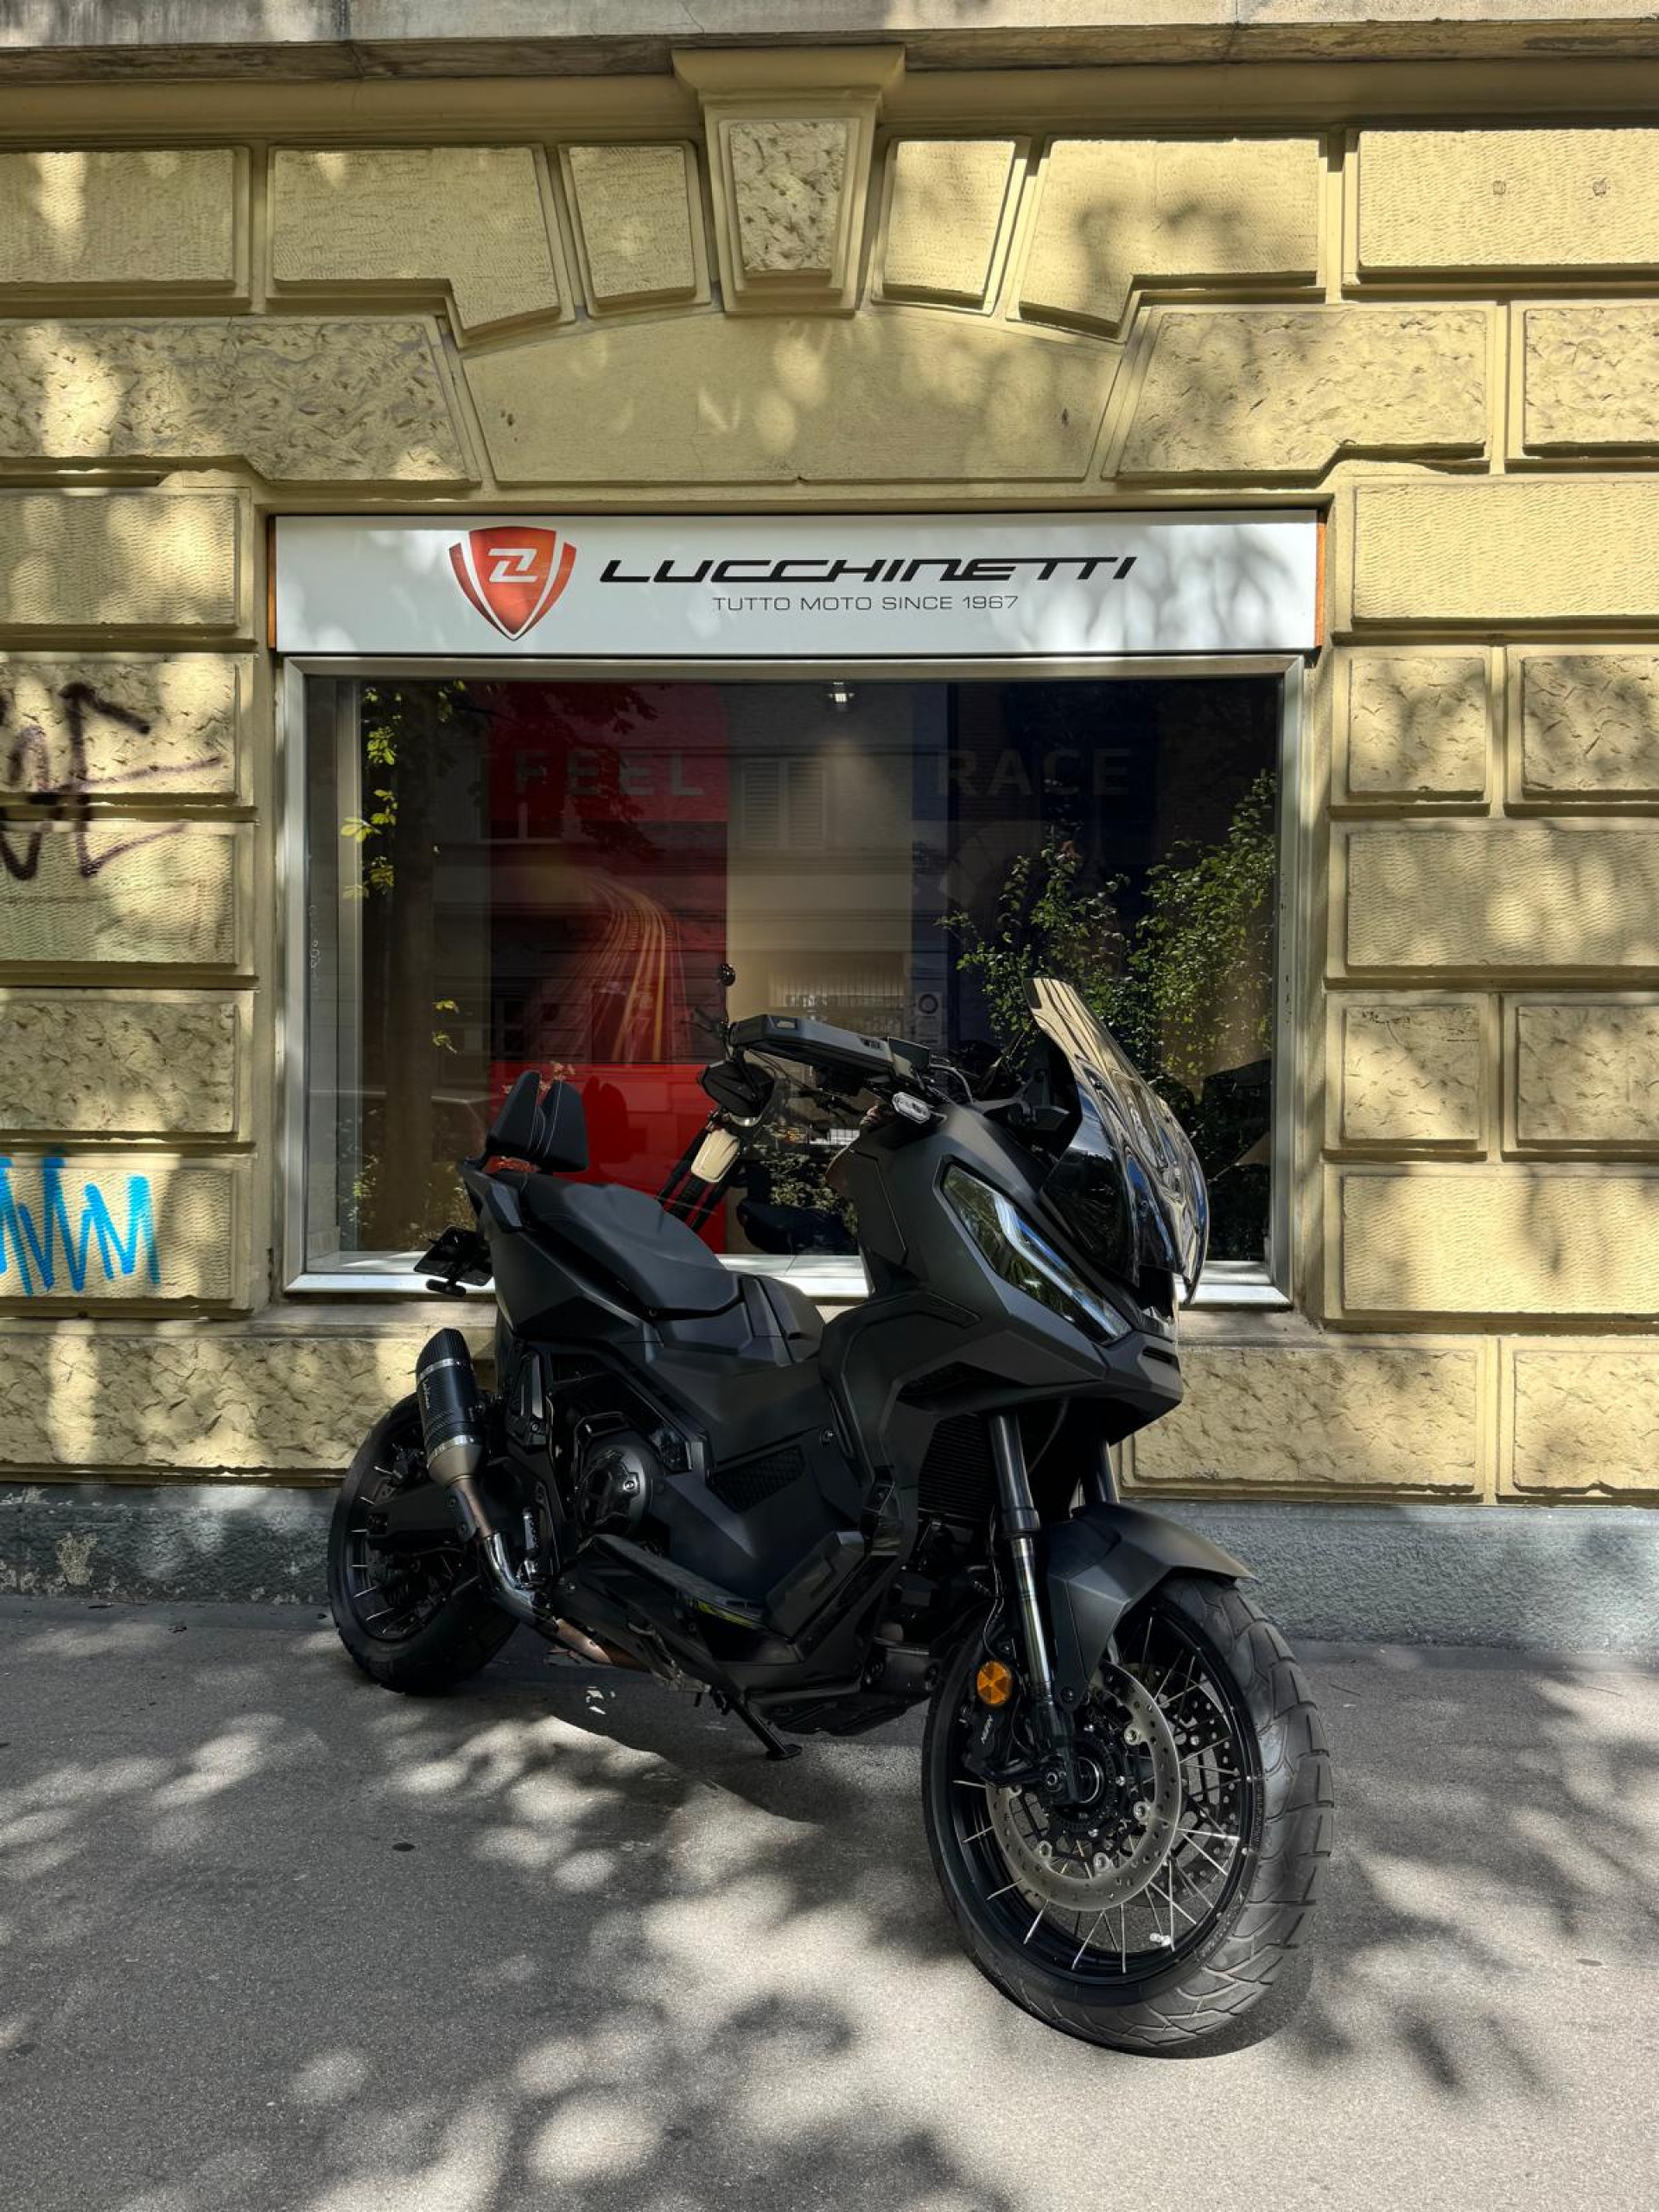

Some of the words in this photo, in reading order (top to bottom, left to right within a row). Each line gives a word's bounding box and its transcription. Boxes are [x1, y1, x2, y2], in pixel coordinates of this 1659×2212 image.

[600, 556, 1137, 583] LUCCHINETTI
[713, 596, 791, 611] TUTTO
[800, 596, 872, 611] MOTO
[882, 596, 952, 610] SINCE
[963, 595, 1019, 610] 1967
[514, 749, 705, 796] FEEL
[938, 748, 1131, 795] RACE
